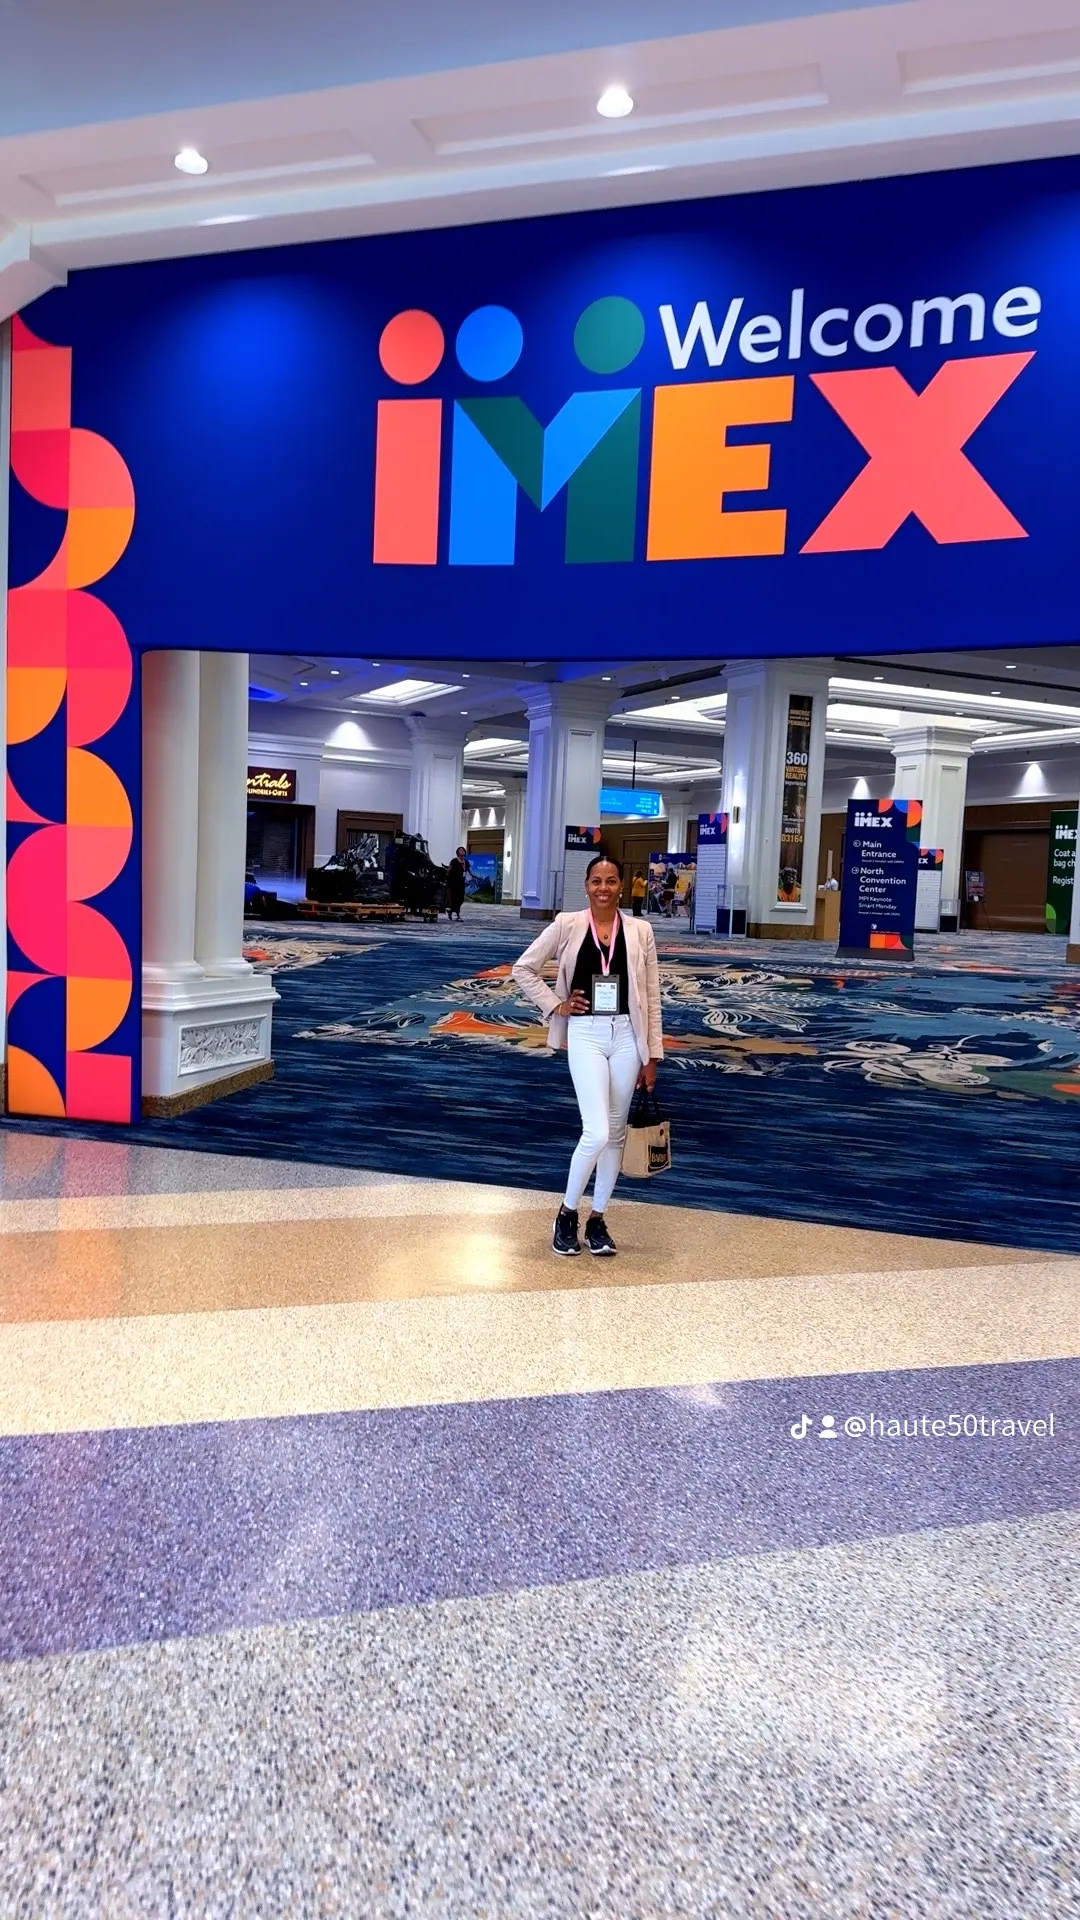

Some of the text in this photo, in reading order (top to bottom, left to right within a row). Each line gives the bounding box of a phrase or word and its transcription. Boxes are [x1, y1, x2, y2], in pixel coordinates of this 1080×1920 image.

[659, 285, 1042, 370] Welcome
[786, 751, 808, 766] 360
[785, 765, 807, 774] VIRTUAL
[247, 772, 292, 789] ntials
[785, 772, 807, 780] REALITY
[781, 833, 803, 844] 03164
[862, 841, 882, 849] Main
[861, 850, 897, 858] Entrance
[1053, 848, 1070, 857] Coat
[918, 857, 929, 865] EX
[1053, 858, 1077, 869] bag ch
[860, 867, 885, 875] North
[859, 875, 907, 885] Convention
[1052, 875, 1075, 886] Regist
[858, 885, 887, 893] Center
[875, 903, 898, 911] Monday
